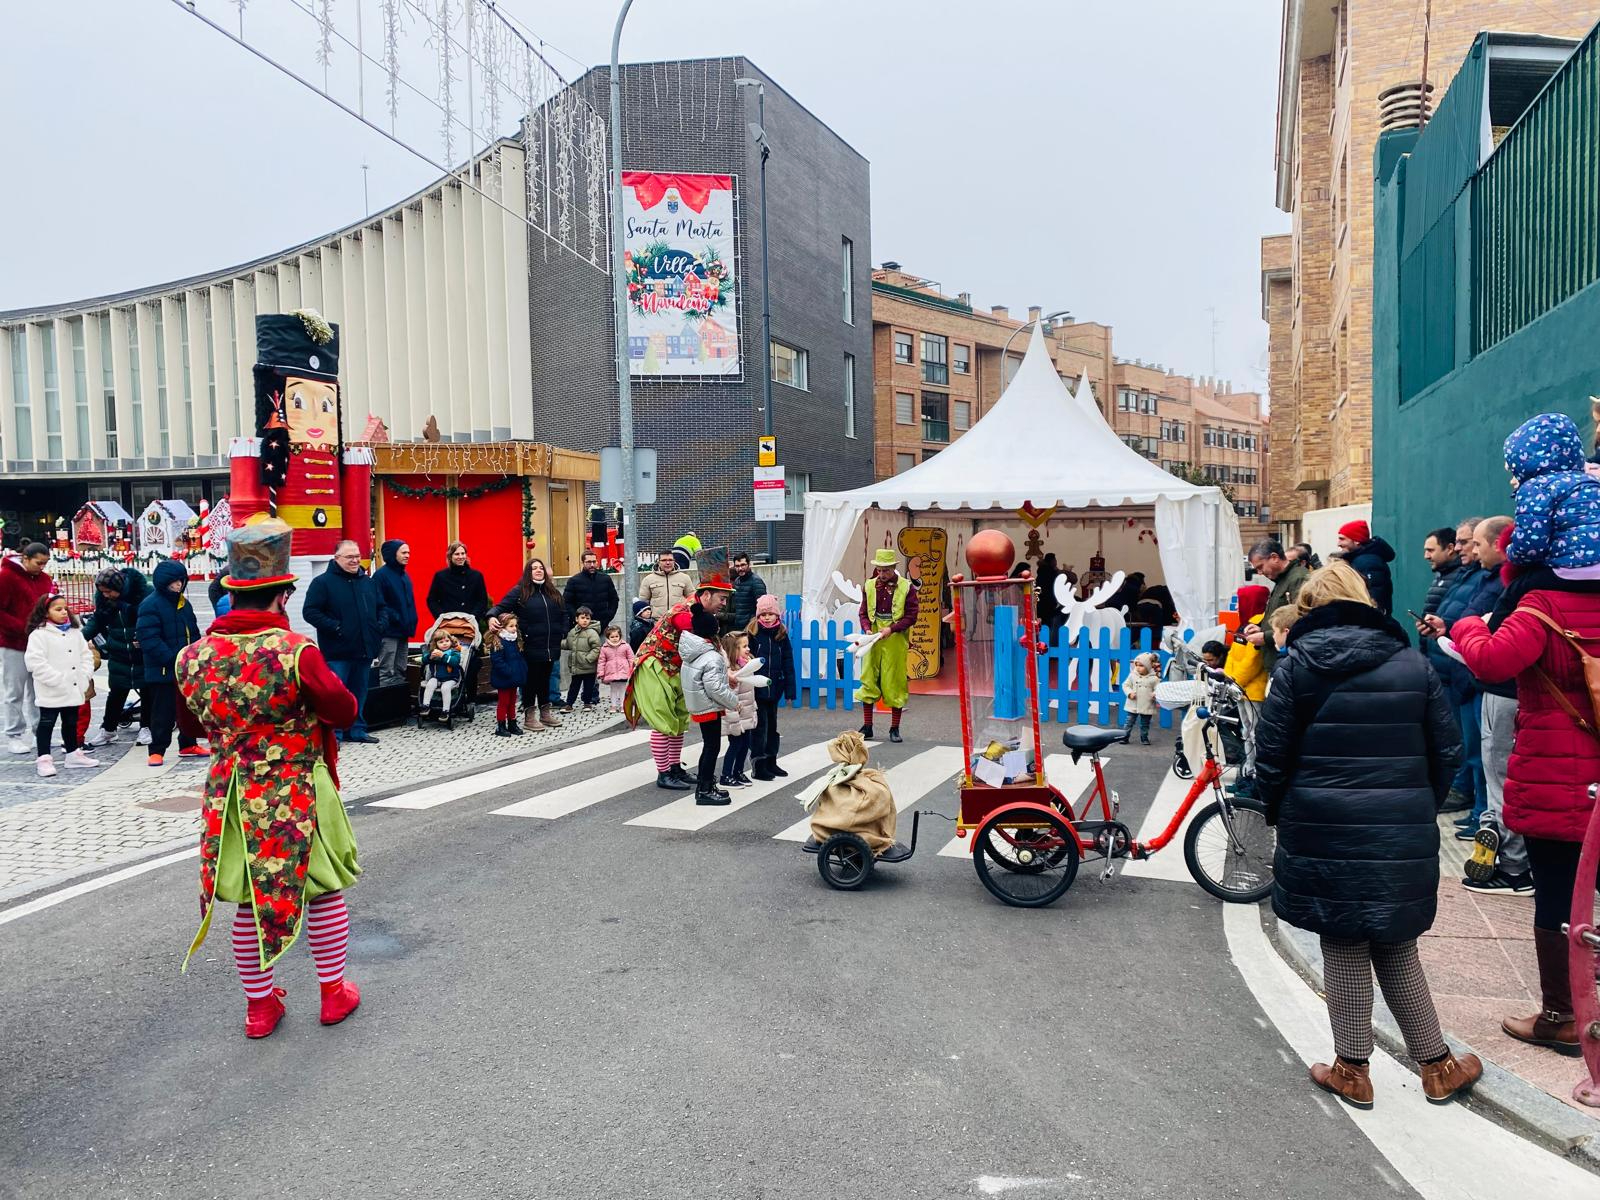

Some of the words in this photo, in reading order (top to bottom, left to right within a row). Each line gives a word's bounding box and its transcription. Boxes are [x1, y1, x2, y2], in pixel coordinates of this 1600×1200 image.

[627, 217, 669, 239] Santa
[676, 219, 723, 239] Marta
[654, 254, 697, 273] Villa
[643, 292, 710, 313] Navideña
